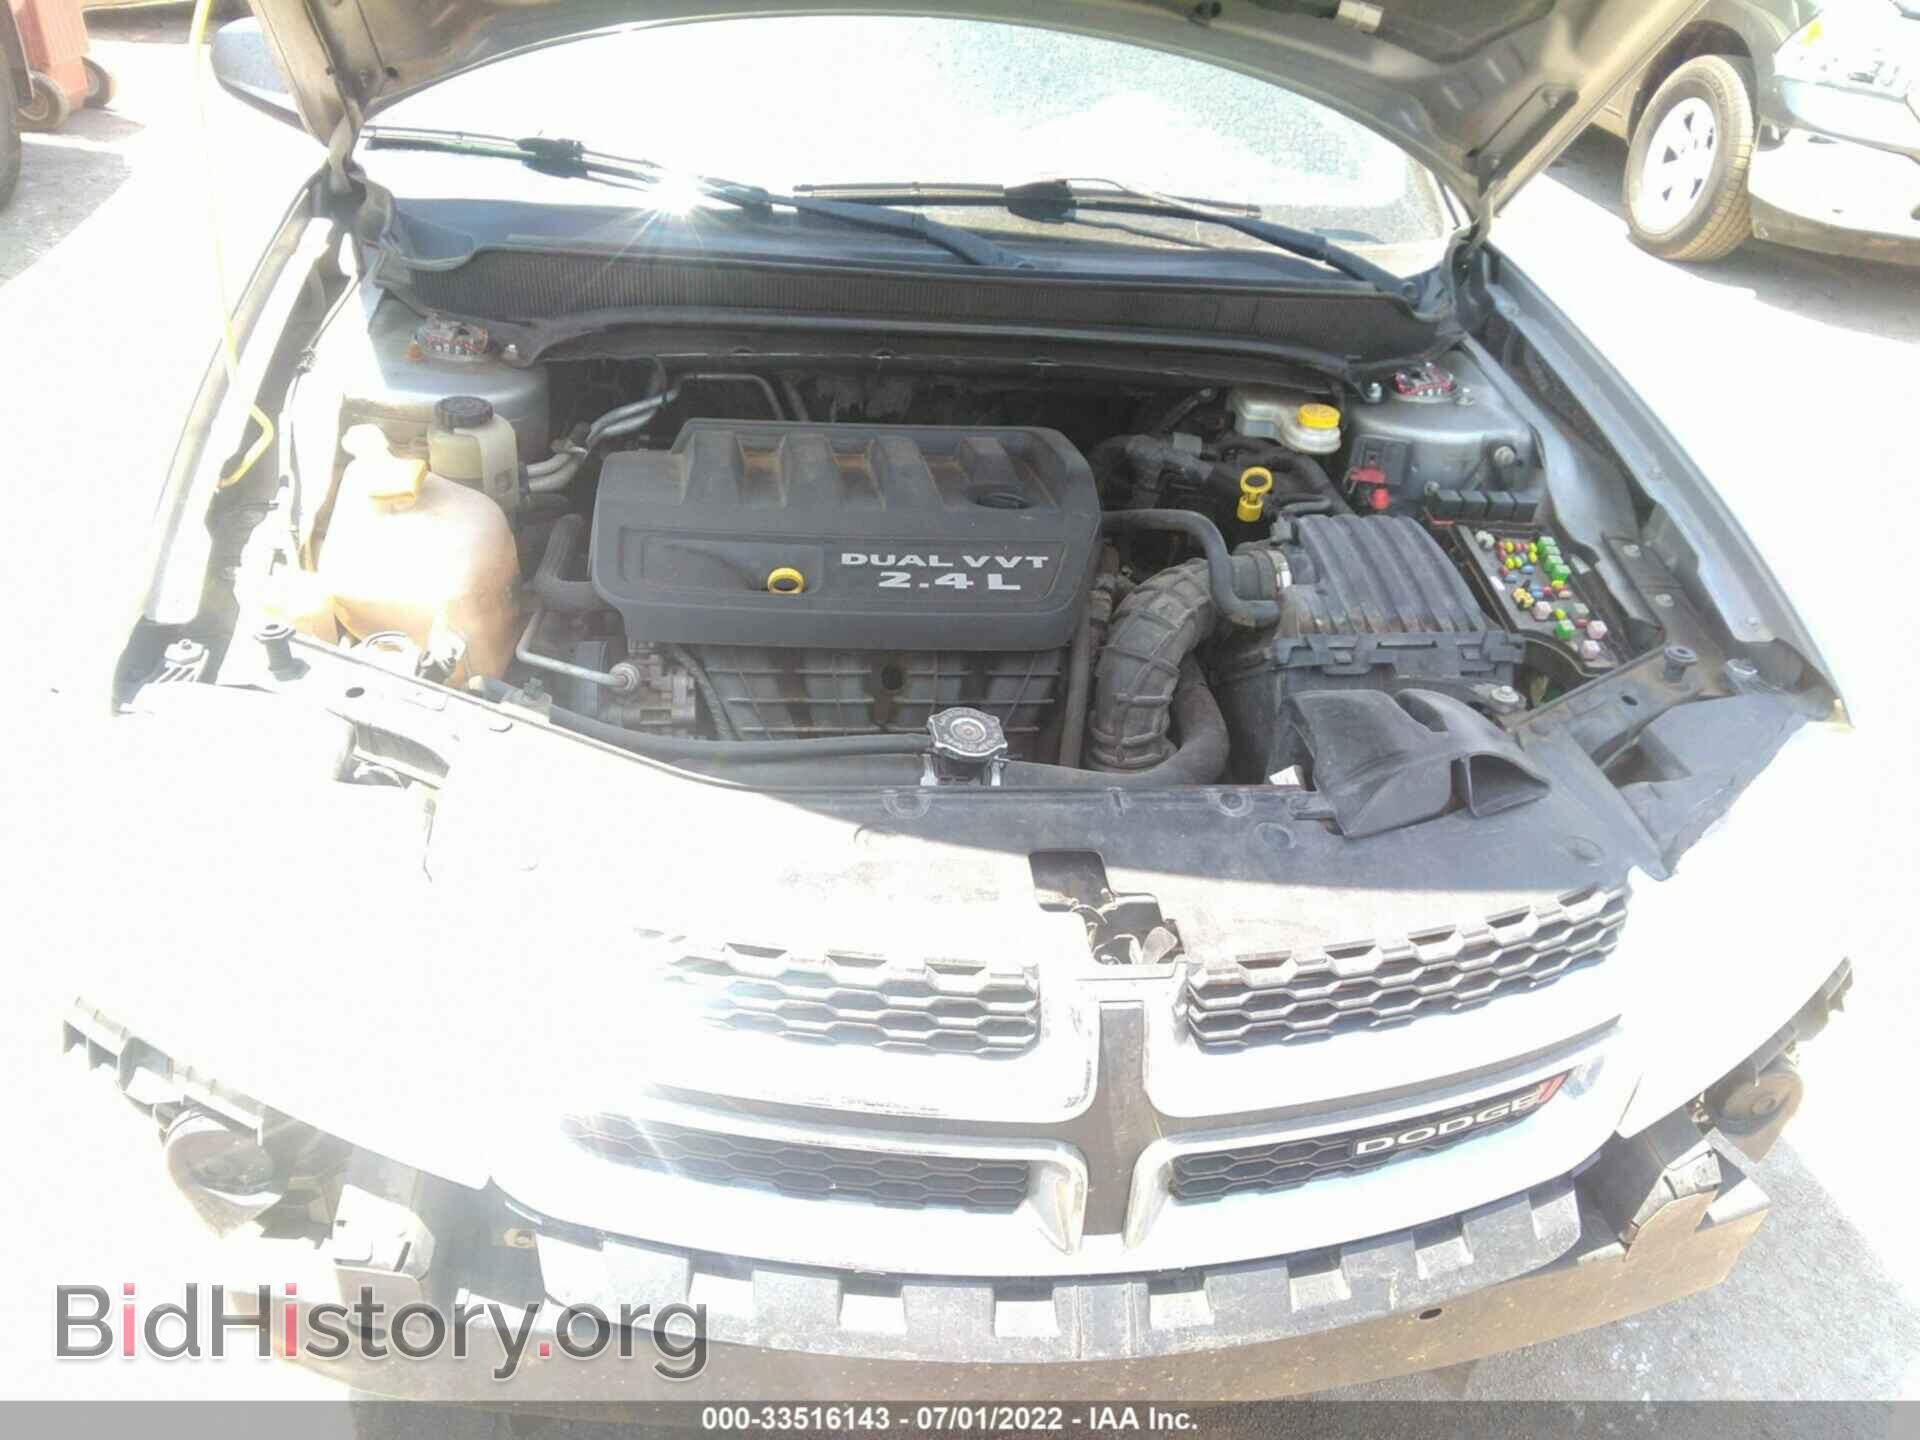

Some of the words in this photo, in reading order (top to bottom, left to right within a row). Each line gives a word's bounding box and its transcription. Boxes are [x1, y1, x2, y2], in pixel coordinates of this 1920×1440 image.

[841, 553, 954, 567] DUAL
[962, 555, 1049, 568] VVT
[1356, 1091, 1539, 1155] DODGE
